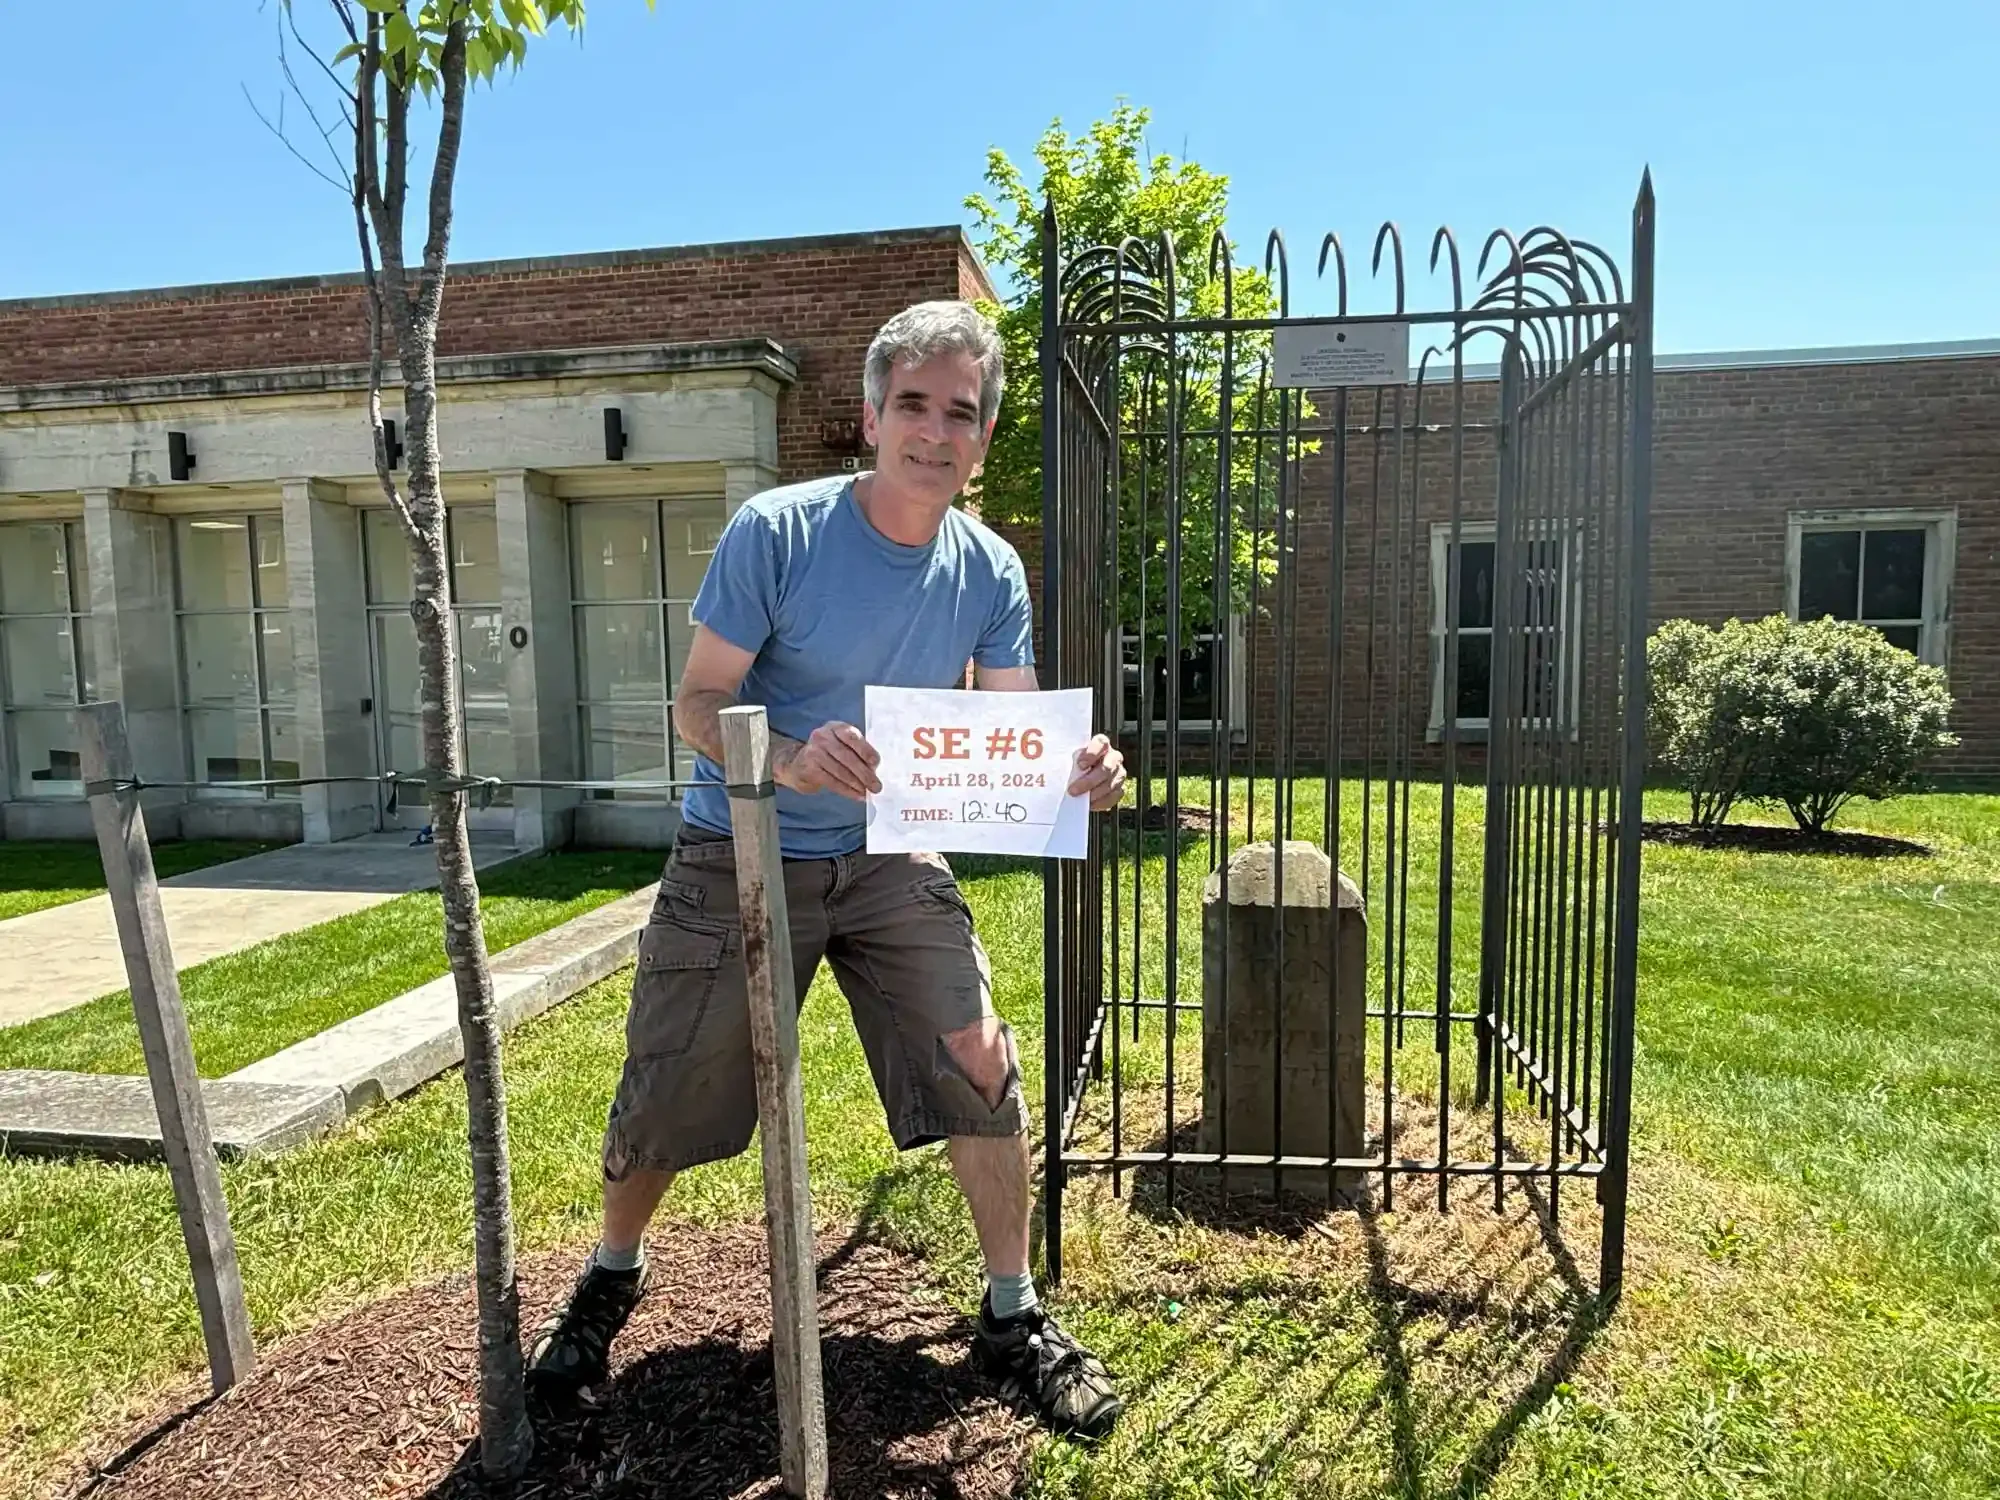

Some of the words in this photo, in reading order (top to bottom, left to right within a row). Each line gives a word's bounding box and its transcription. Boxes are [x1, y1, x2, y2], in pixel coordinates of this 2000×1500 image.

[913, 727, 970, 760] SE
[985, 727, 1044, 760] #6
[910, 773, 961, 790] April
[966, 774, 995, 790] 28,
[1001, 774, 1046, 788] 2024
[900, 808, 954, 821] TIME:
[961, 800, 1027, 823] 12:40
